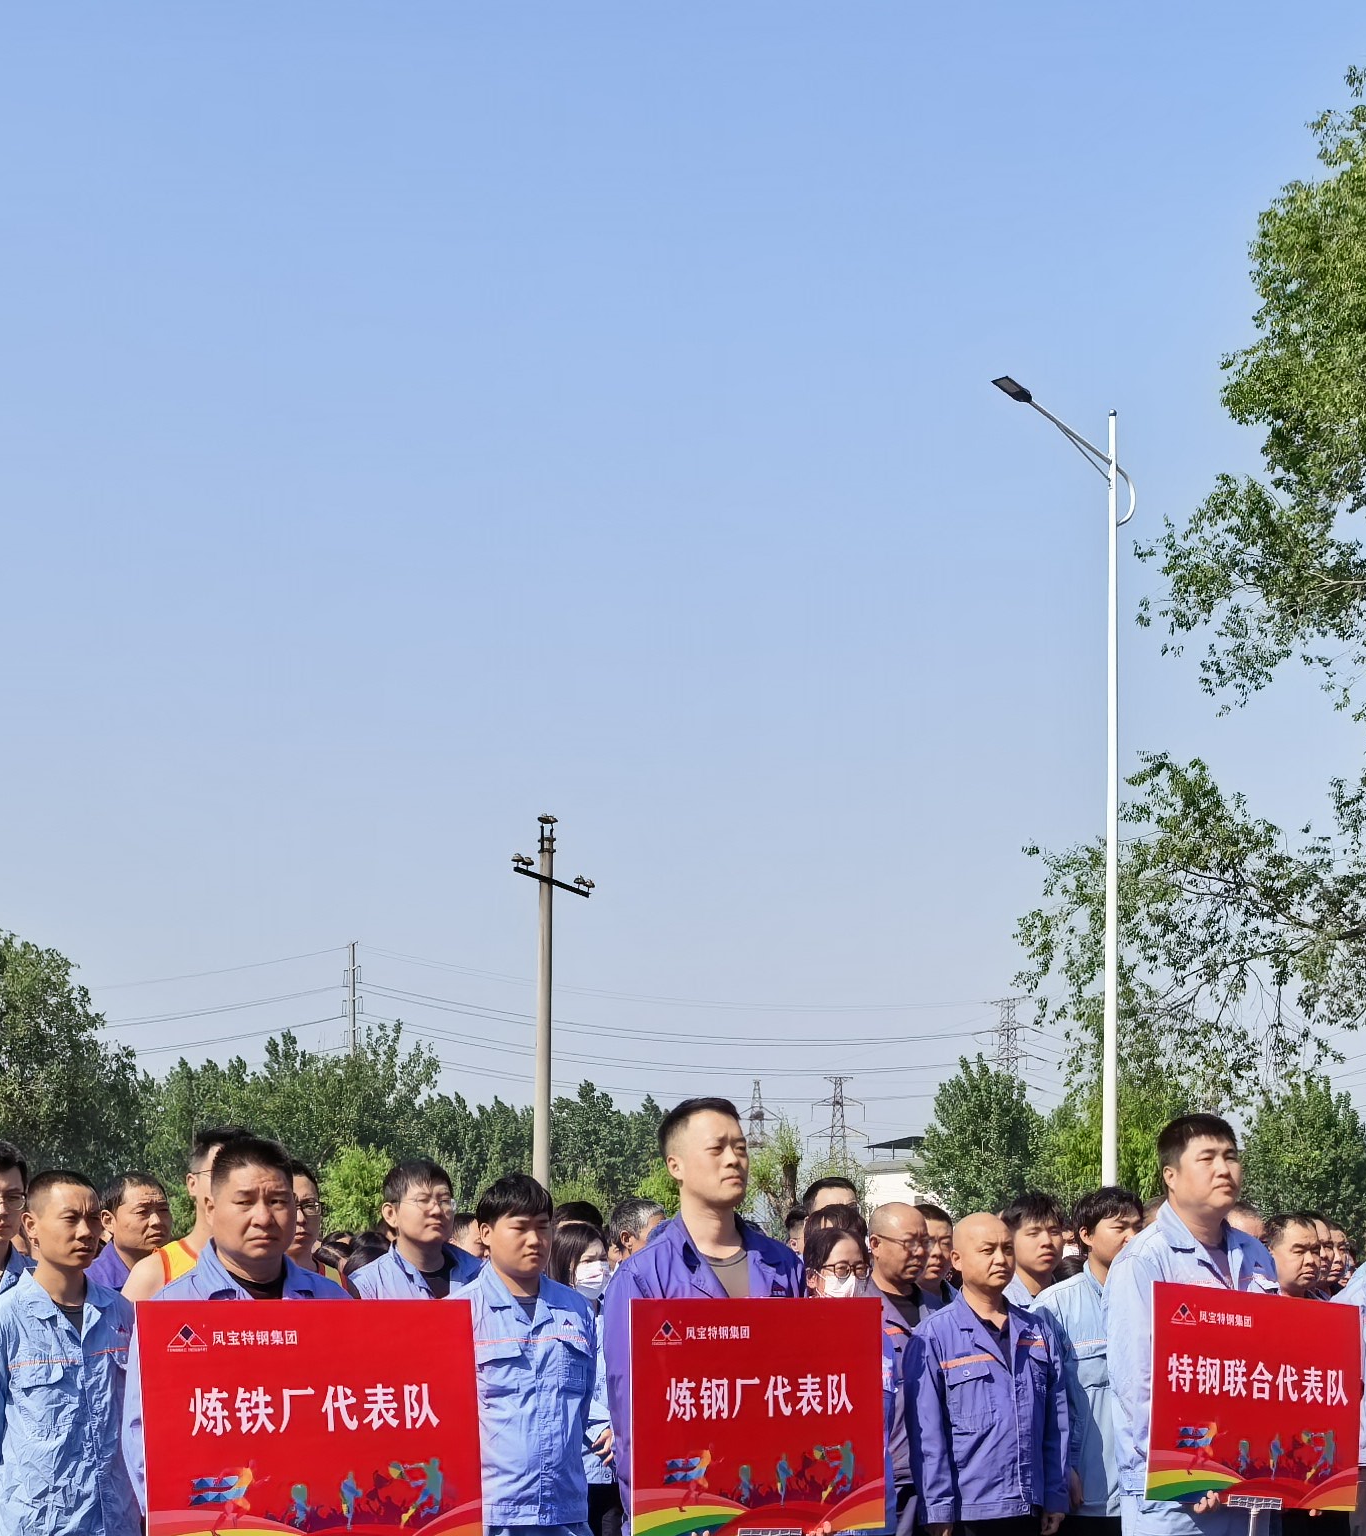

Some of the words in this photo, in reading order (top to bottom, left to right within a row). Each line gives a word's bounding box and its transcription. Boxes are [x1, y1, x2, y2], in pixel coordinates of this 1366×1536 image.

[212, 1330, 298, 1346] 凤宝特钢集团
[685, 1325, 750, 1341] 凤宝特钢集团
[665, 1372, 854, 1422] 炼钢厂代表队
[1167, 1352, 1349, 1407] 特钢联合代表队
[188, 1383, 440, 1437] 炼铁厂代表队
